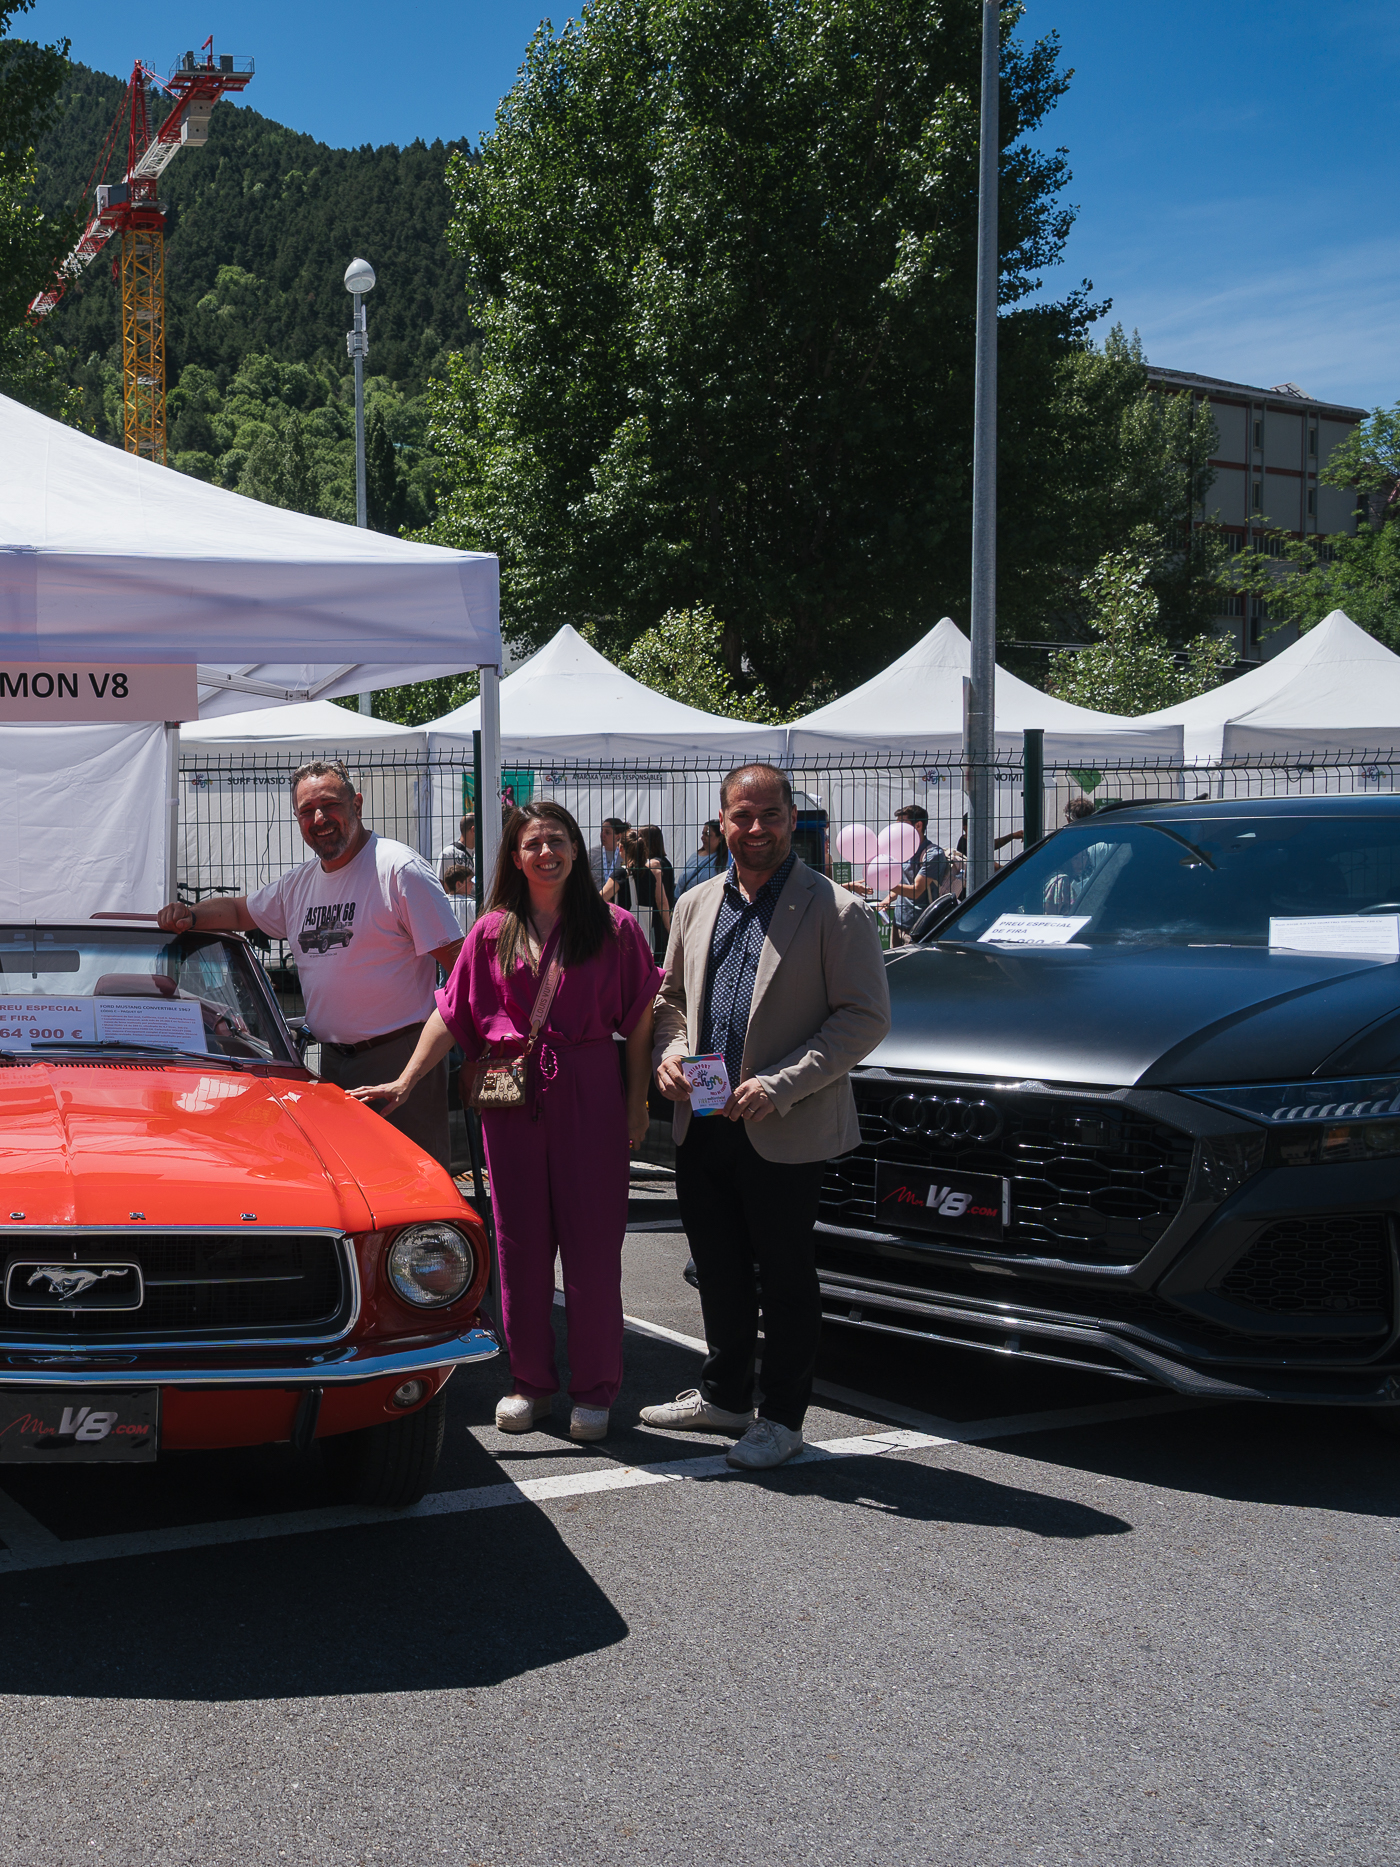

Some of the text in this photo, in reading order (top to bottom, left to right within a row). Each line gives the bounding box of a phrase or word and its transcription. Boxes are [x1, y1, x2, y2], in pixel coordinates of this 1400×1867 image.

[0, 672, 129, 698] MON V8
[227, 777, 251, 785] SURF
[253, 775, 286, 785] EVASIÓ
[342, 901, 356, 921] 68
[0, 1028, 83, 1039] 64 900 €
